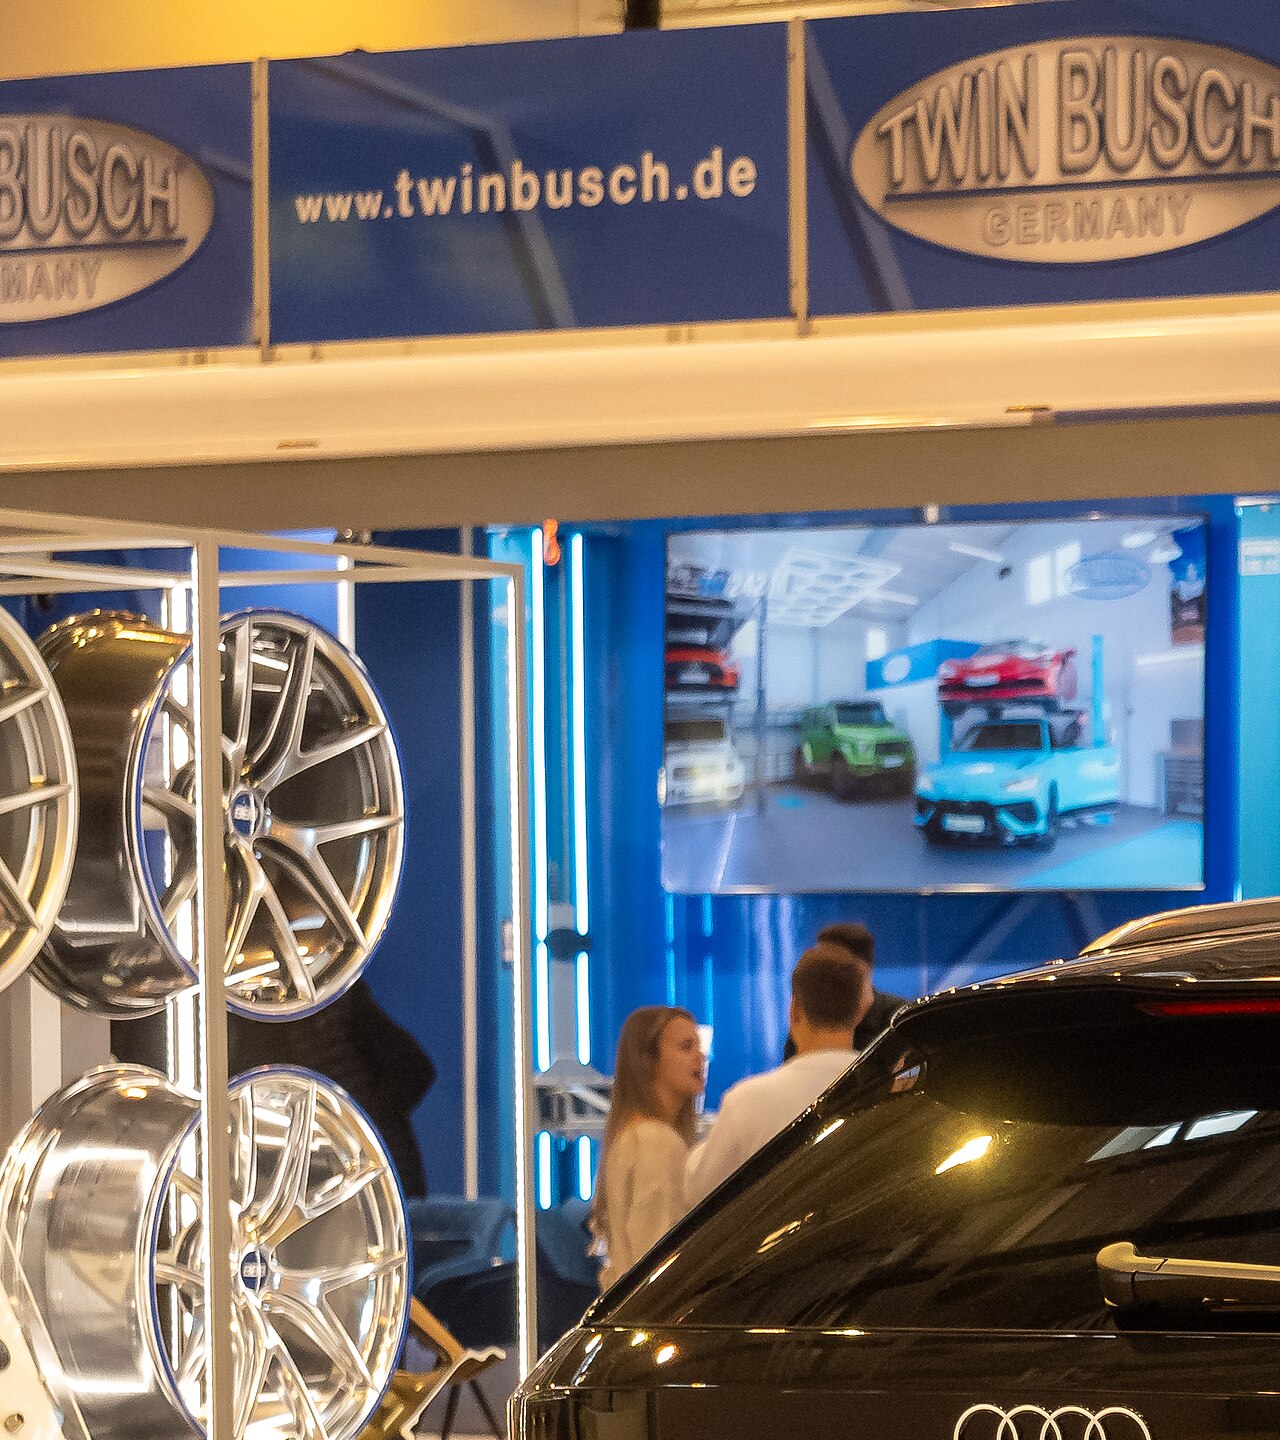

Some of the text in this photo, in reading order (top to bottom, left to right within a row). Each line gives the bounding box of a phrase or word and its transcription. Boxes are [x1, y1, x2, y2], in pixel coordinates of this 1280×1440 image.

[876, 52, 1038, 190] TWIN
[294, 146, 758, 224] www.twinbusch.de
[981, 195, 1192, 247] GERMANY
